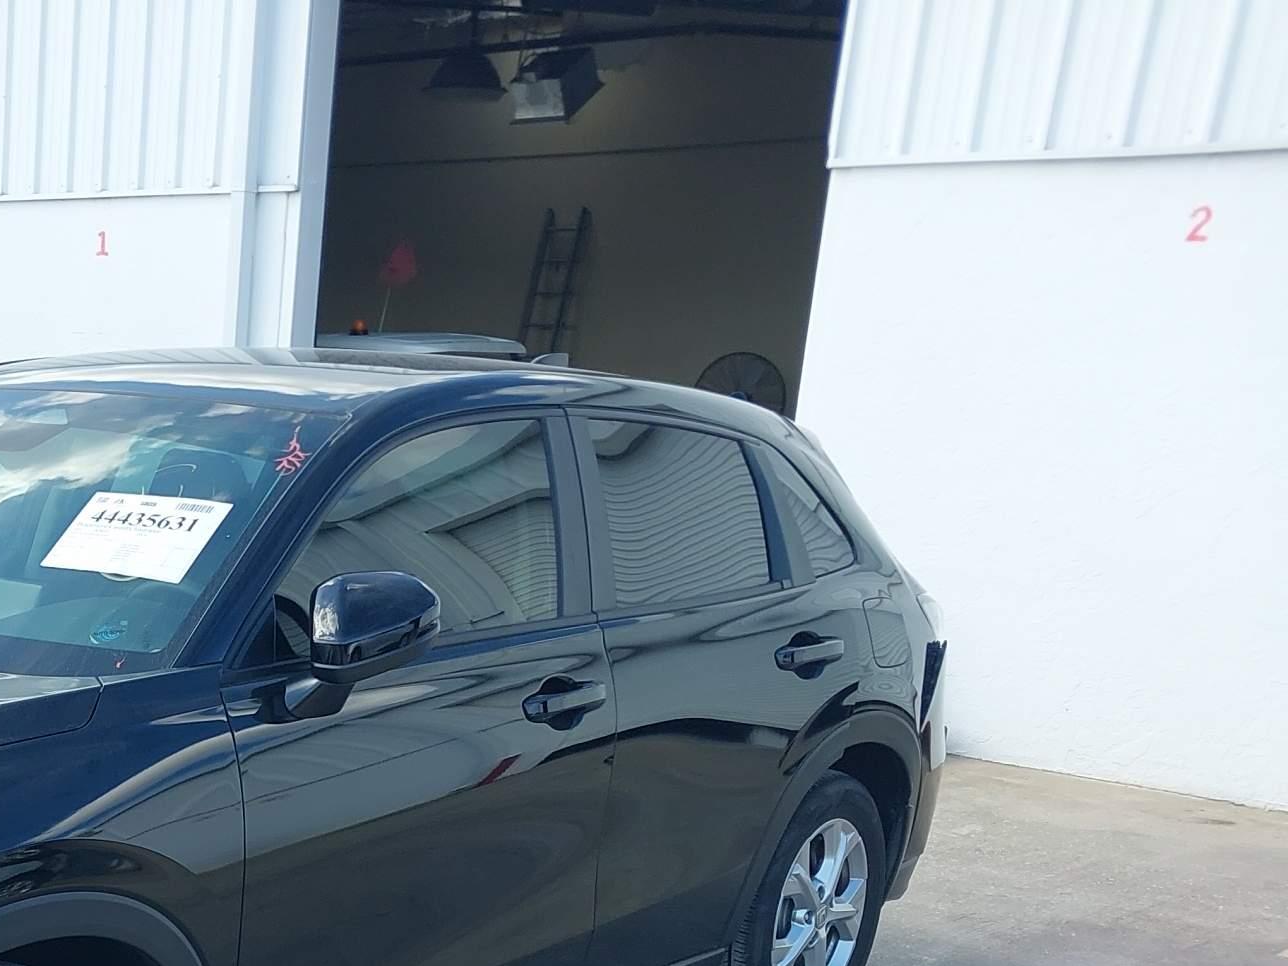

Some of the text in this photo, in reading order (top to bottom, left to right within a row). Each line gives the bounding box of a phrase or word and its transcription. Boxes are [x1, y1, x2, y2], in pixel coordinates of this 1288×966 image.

[1186, 205, 1213, 242] 2
[95, 230, 109, 257] 1
[91, 509, 199, 532] 44435631
